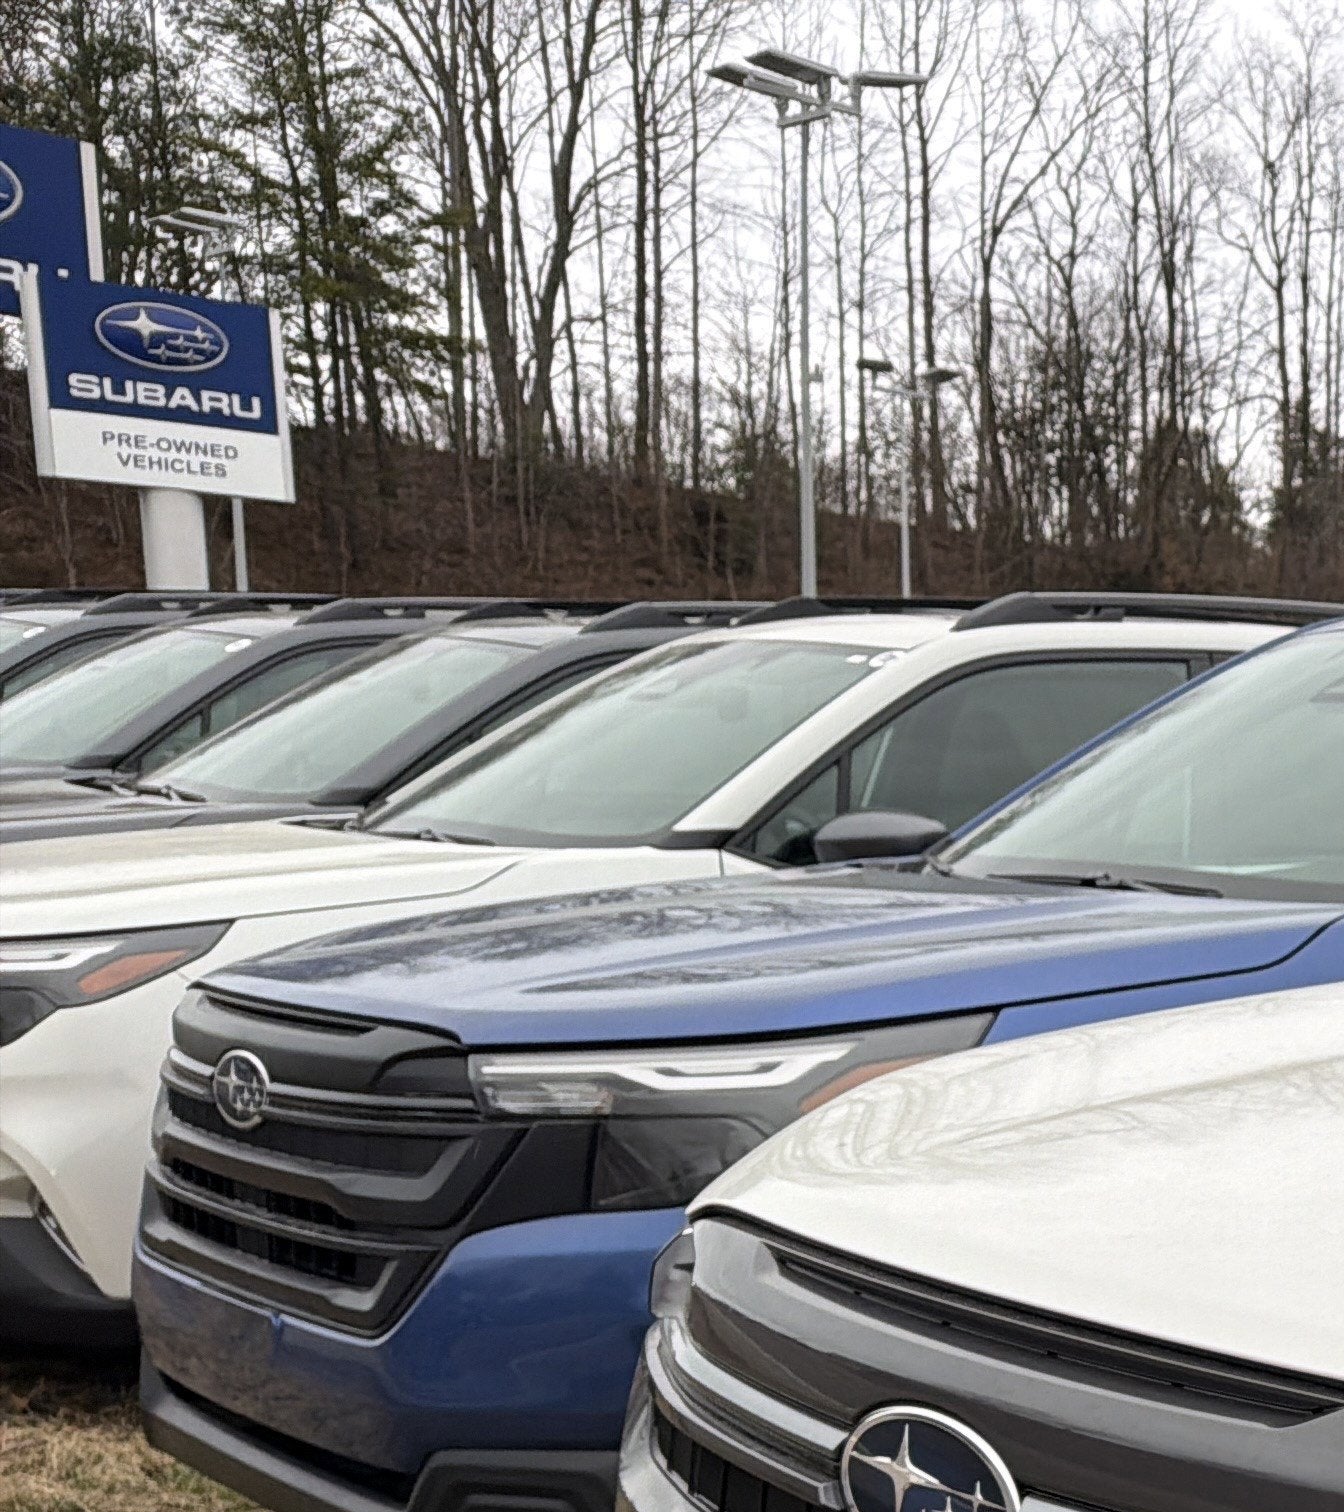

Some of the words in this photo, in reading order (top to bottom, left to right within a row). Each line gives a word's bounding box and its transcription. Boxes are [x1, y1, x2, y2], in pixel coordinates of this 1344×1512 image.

[68, 372, 262, 420] SUBARU
[101, 430, 239, 460] PRE-OWNED
[116, 451, 228, 478] VEHICLES
